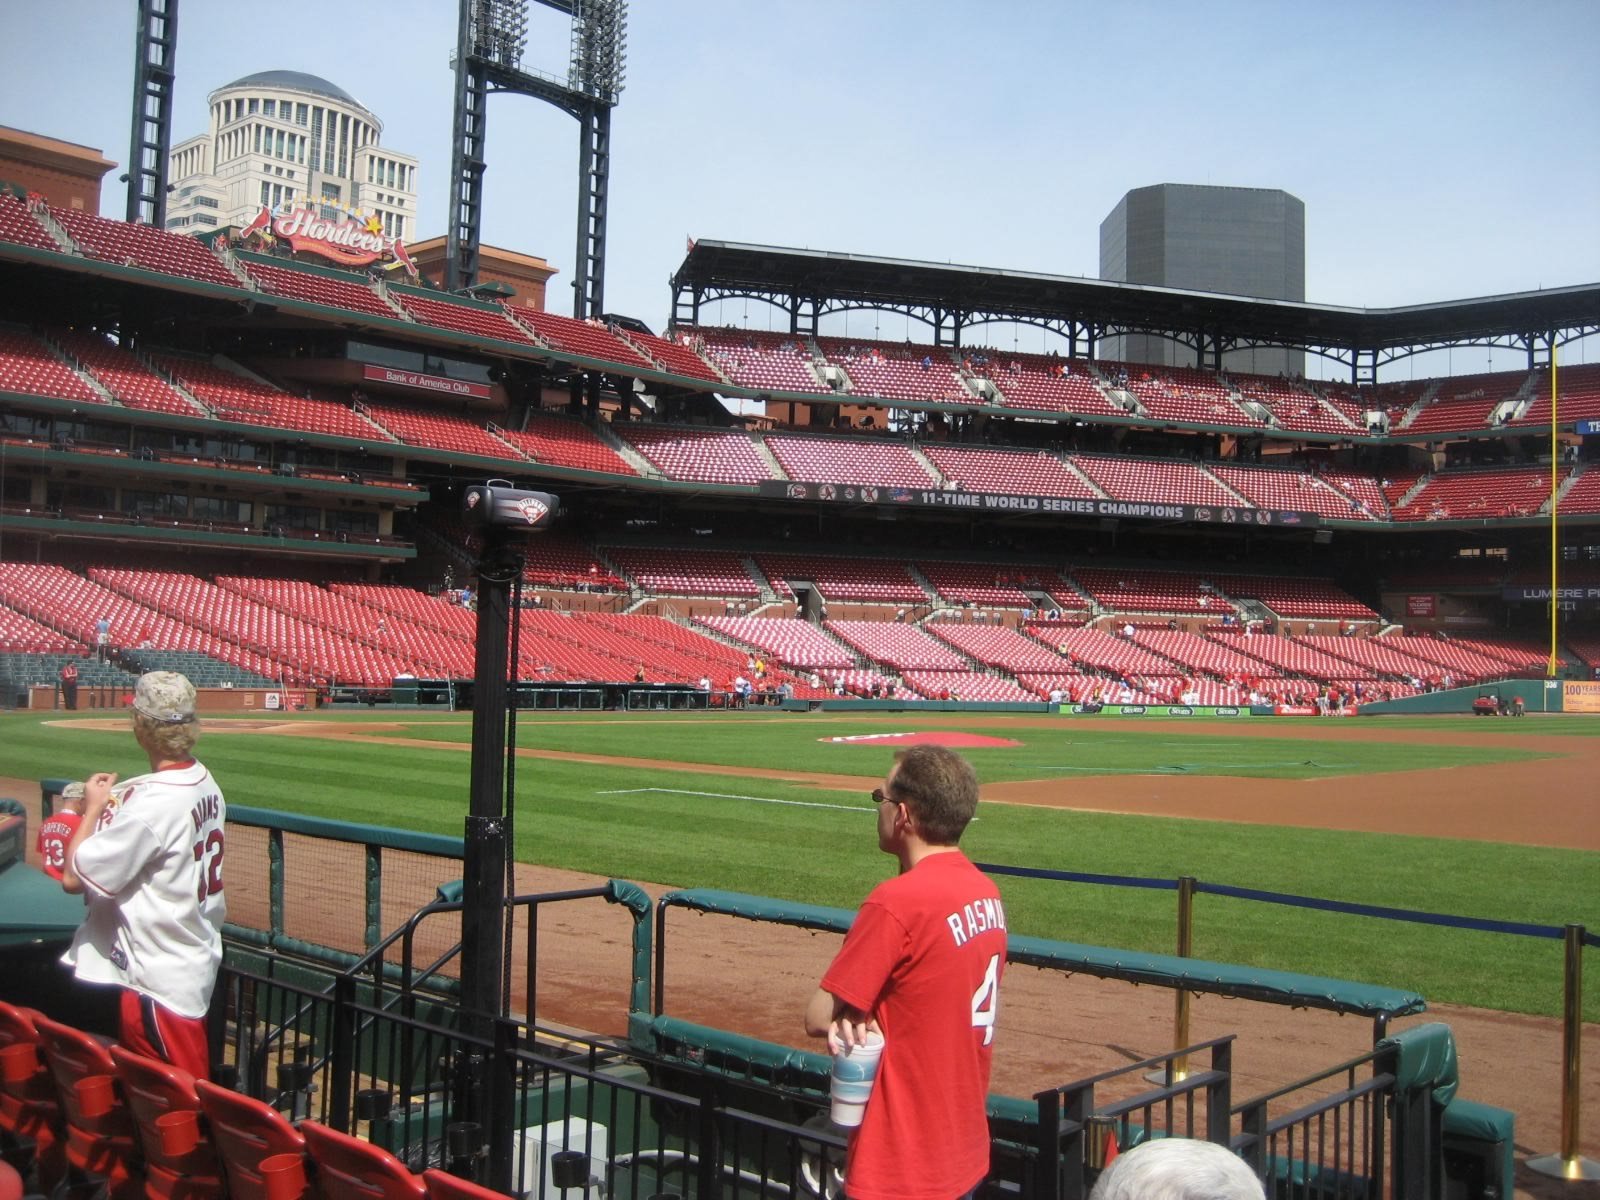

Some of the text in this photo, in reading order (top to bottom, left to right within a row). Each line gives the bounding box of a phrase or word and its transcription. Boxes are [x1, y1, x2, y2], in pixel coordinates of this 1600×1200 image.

[386, 371, 470, 393] Bank of America Club
[921, 491, 1183, 518] 11-TIME WORLD SERIES CHAMPIONS
[1565, 685, 1581, 695] 100
[45, 839, 65, 867] 13
[947, 898, 1007, 947] RASMU
[971, 954, 1000, 1046] 4
